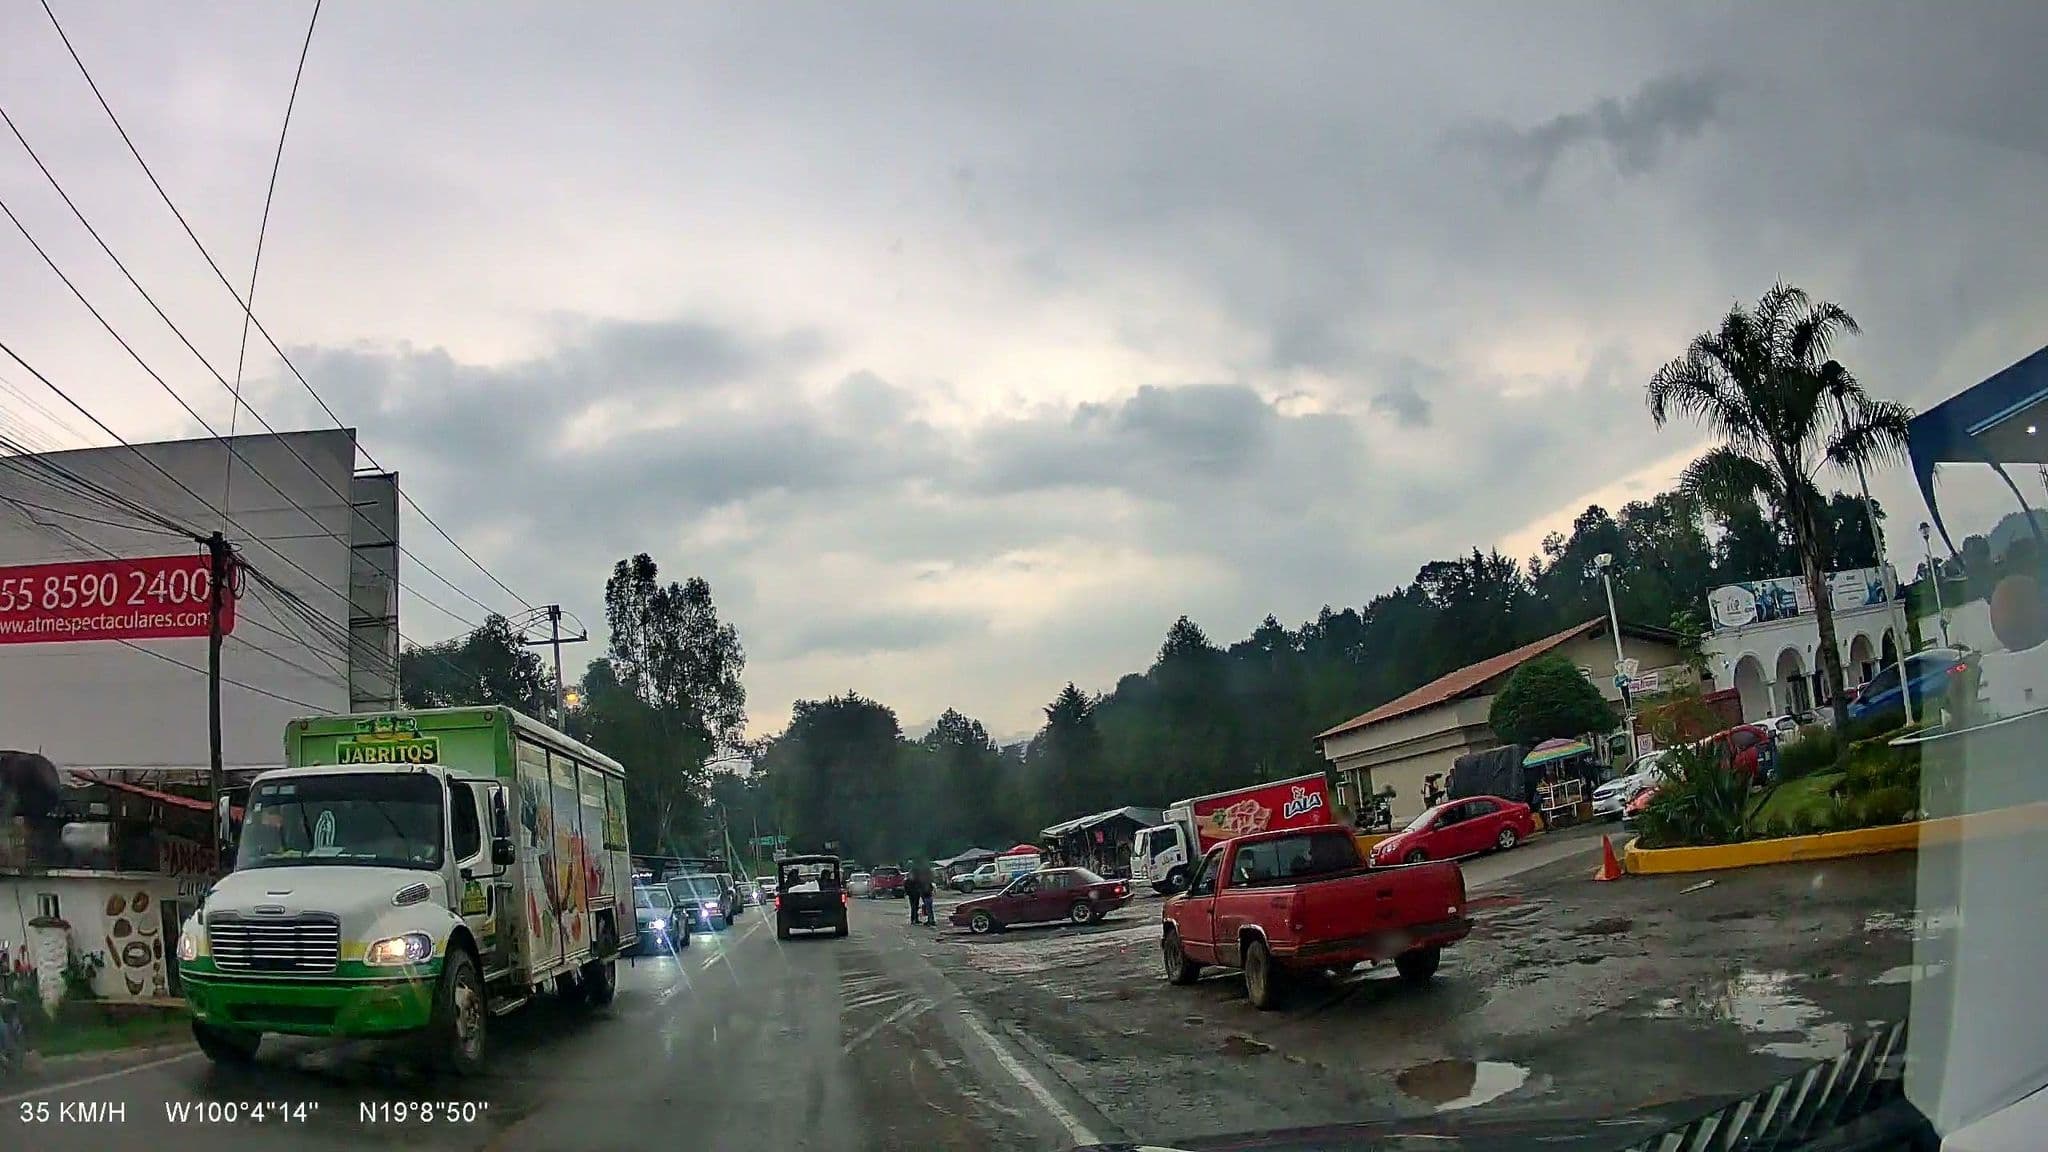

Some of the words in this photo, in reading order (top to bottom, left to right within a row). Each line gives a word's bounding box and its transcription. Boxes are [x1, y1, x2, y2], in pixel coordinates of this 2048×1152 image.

[0, 578, 34, 612] 55
[42, 573, 119, 610] 8590
[127, 567, 211, 605] 2400
[1284, 792, 1323, 819] LALA
